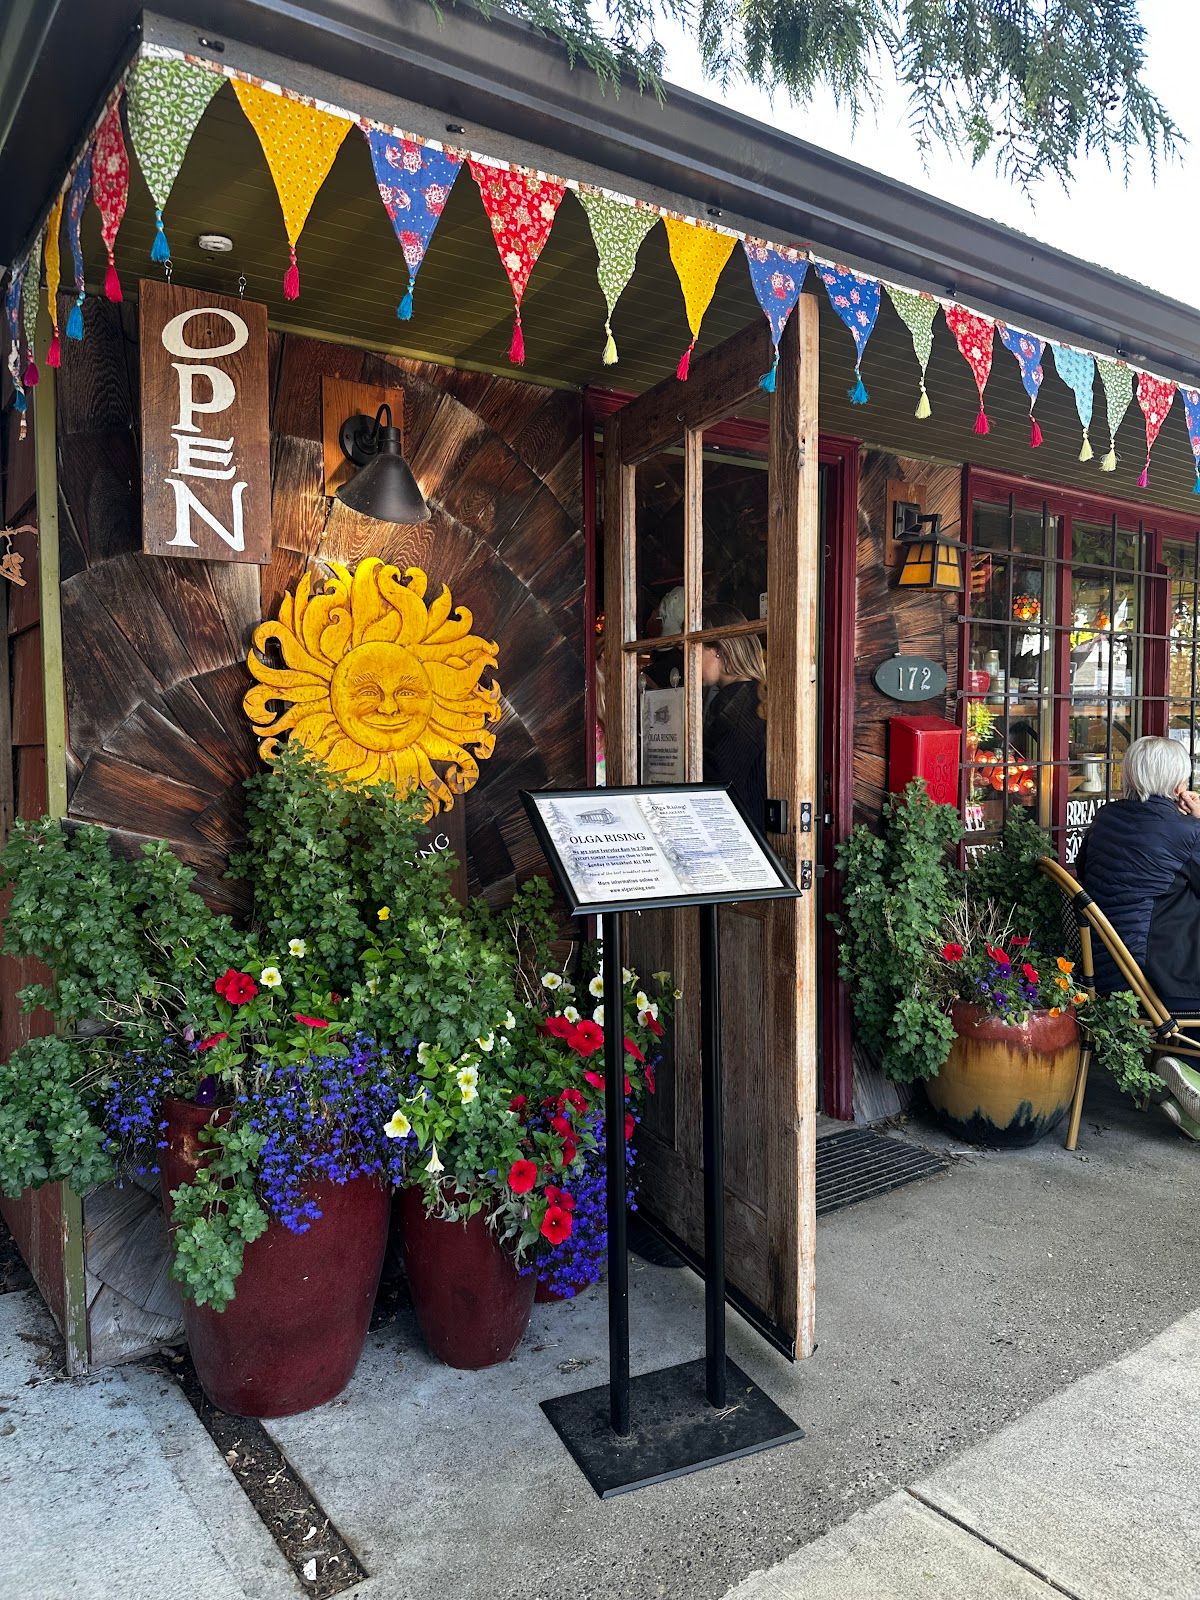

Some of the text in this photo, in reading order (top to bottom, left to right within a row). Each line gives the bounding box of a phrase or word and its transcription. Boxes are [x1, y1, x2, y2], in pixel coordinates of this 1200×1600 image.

[162, 307, 249, 552] OPEN
[898, 667, 931, 691] 172
[569, 832, 646, 844] OLGA RISING
